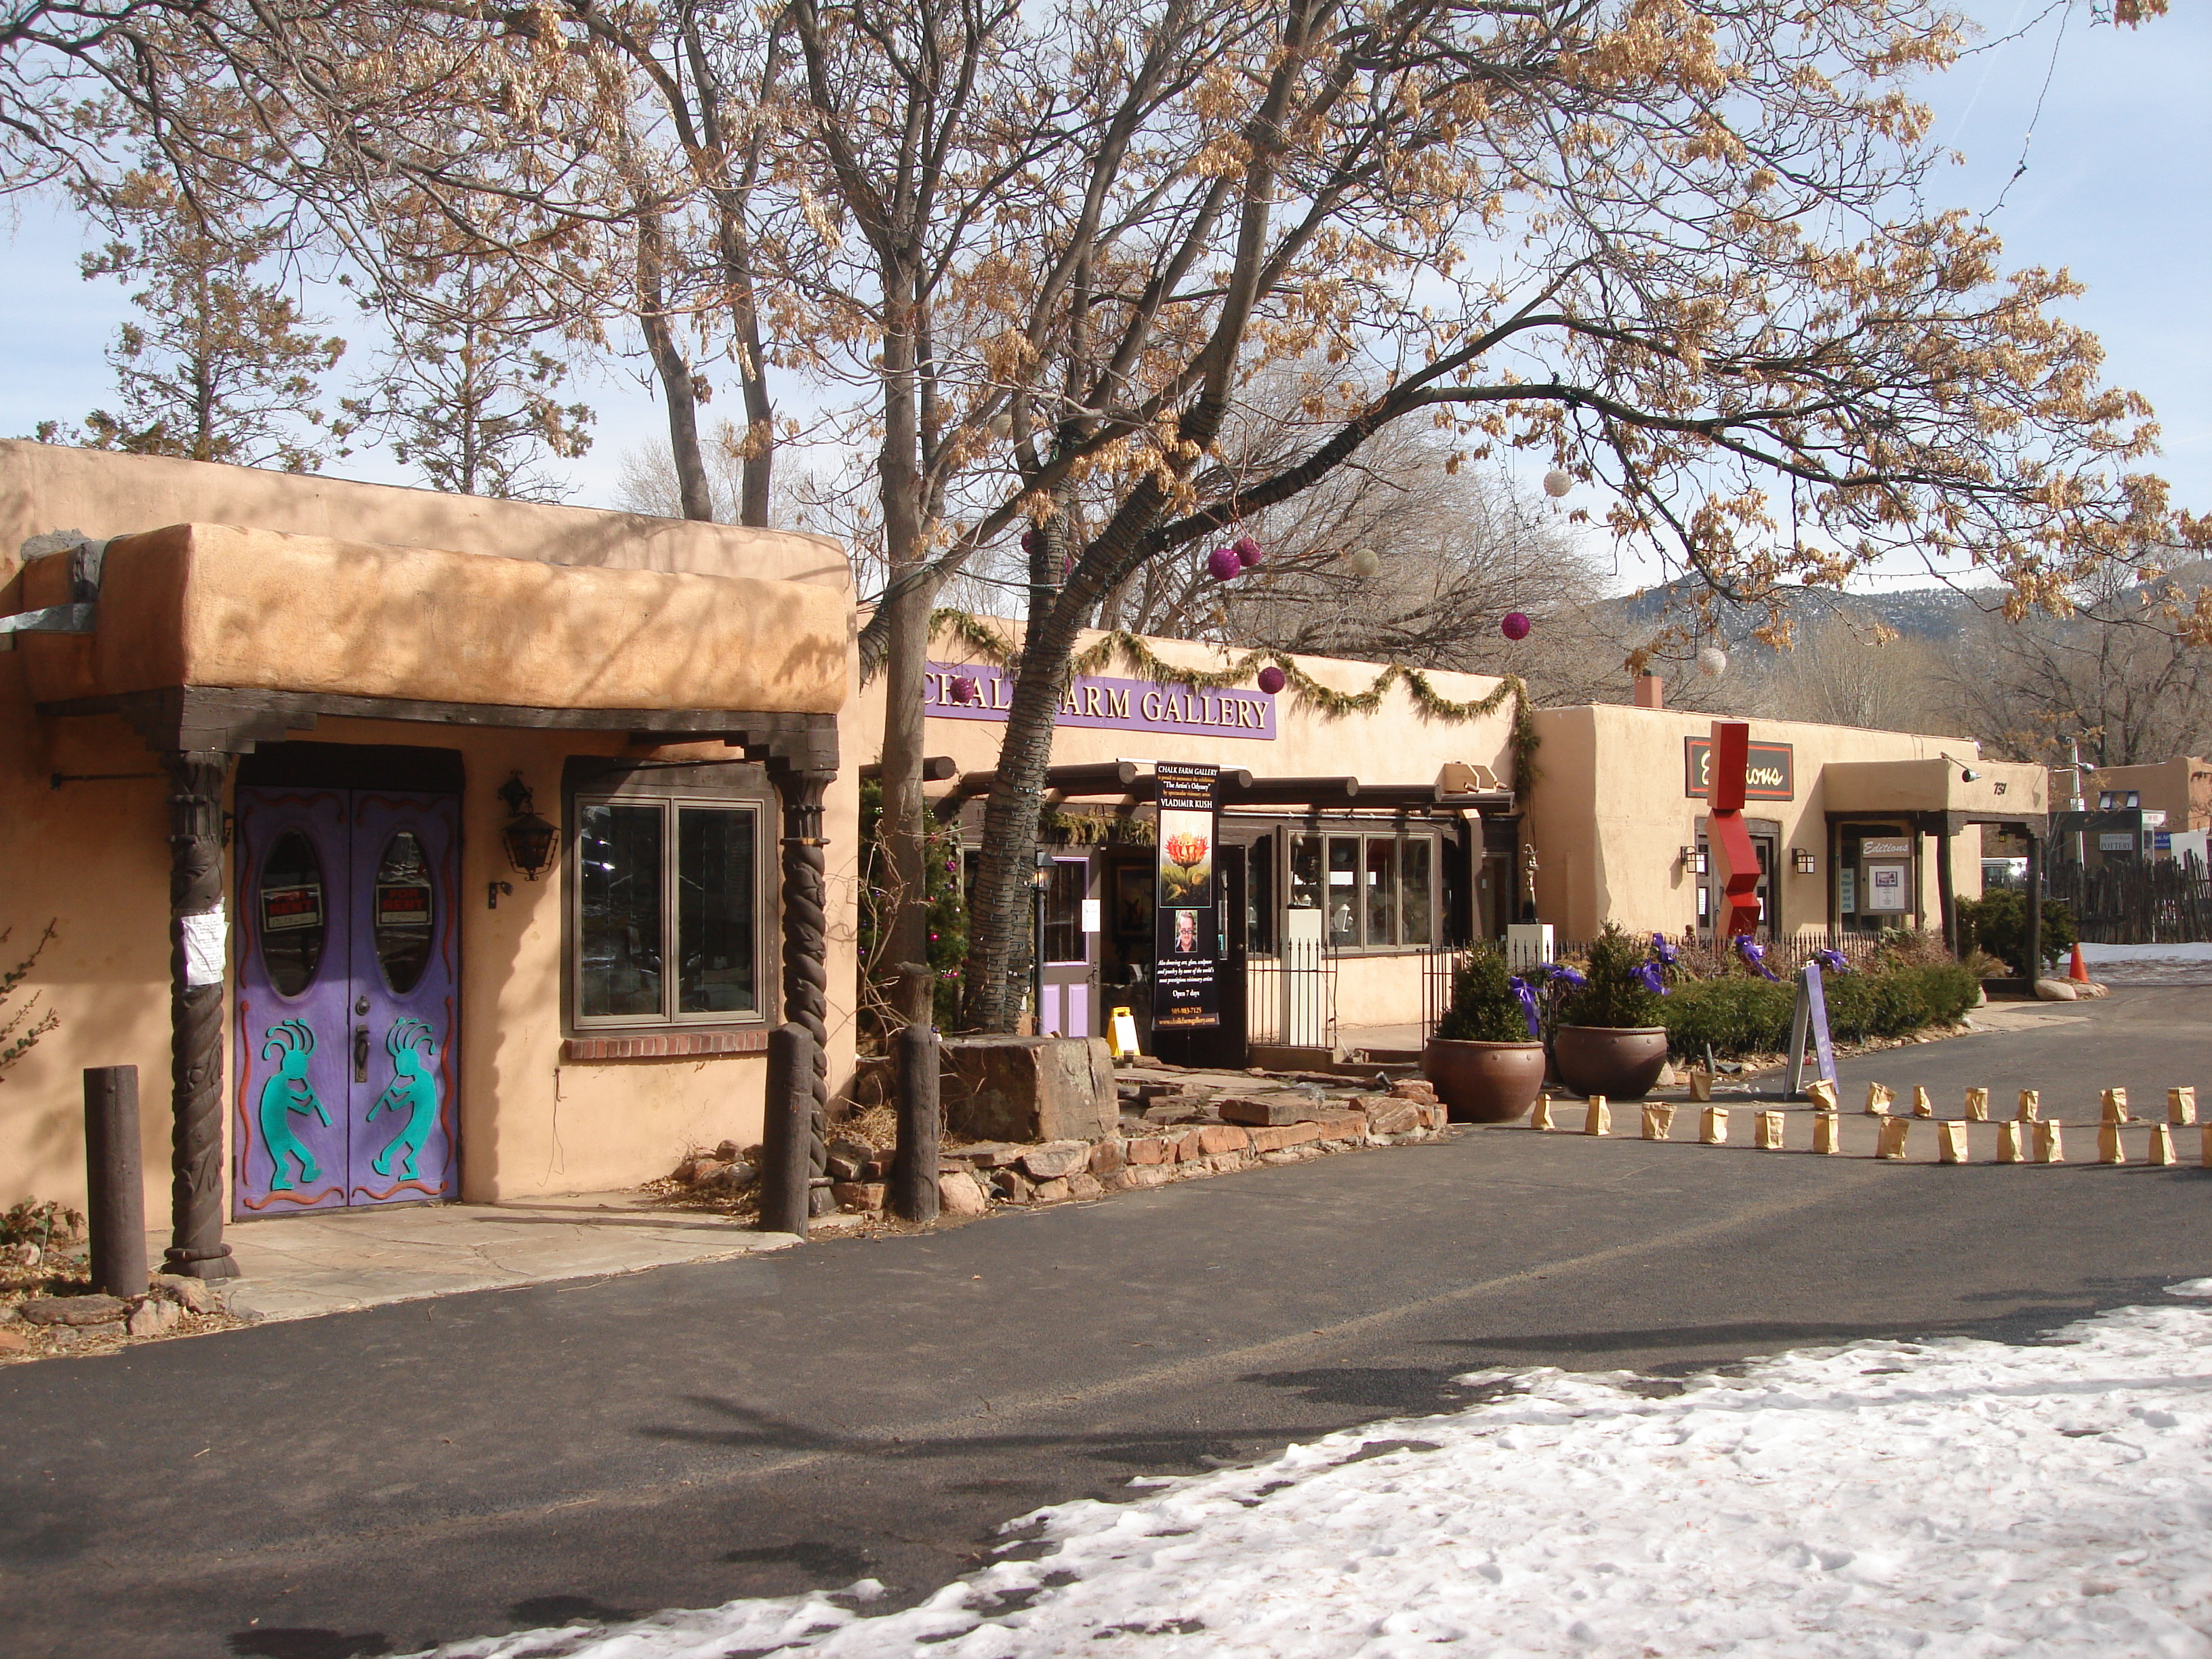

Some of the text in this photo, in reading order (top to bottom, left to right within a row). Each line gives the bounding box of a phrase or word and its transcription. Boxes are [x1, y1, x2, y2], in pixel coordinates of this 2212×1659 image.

[924, 672, 1269, 729] CHAL ARM GALLERY
[1158, 766, 1218, 776] CHALK FARM GALLERY
[1701, 750, 1784, 786] Eions
[1994, 782, 2007, 796] 731
[1160, 798, 1212, 808] VLADIMIR KUSH
[1863, 841, 1909, 855] Editions
[2101, 842, 2131, 850] POTTERY
[388, 888, 419, 899] FOR
[269, 899, 313, 915] RENT
[382, 899, 425, 911] RENT
[1192, 967, 1197, 975] of
[1172, 989, 1185, 999] Open
[1190, 989, 1200, 998] days
[1159, 1016, 1215, 1025] www.chalkfarmgallery.com
